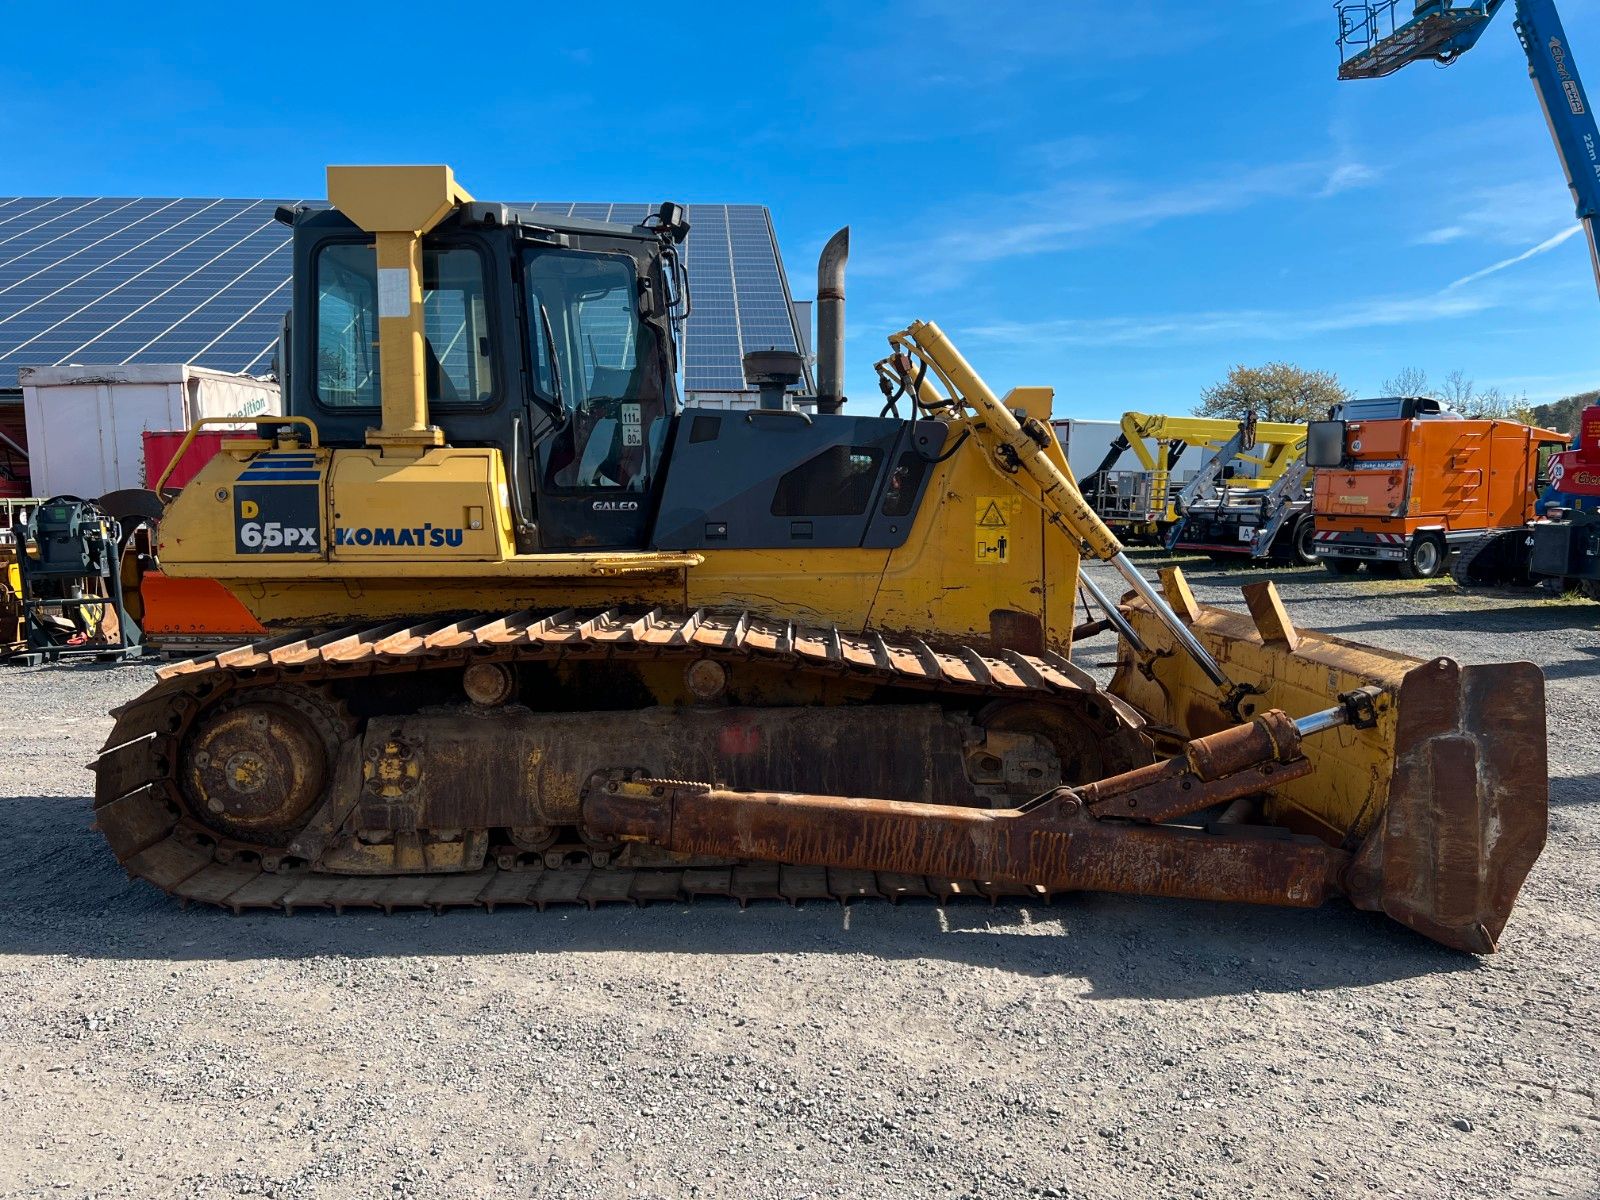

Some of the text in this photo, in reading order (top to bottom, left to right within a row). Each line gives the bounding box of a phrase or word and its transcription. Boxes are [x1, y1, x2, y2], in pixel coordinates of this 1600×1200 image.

[1583, 133, 1597, 161] 22m
[624, 412, 636, 423] 111
[627, 434, 637, 444] 80
[1555, 466, 1562, 477] 20
[241, 501, 259, 519] D
[592, 501, 638, 510] GALEO
[240, 522, 317, 547] 65PX
[336, 523, 463, 547] KOMATSU
[1243, 528, 1250, 538] A
